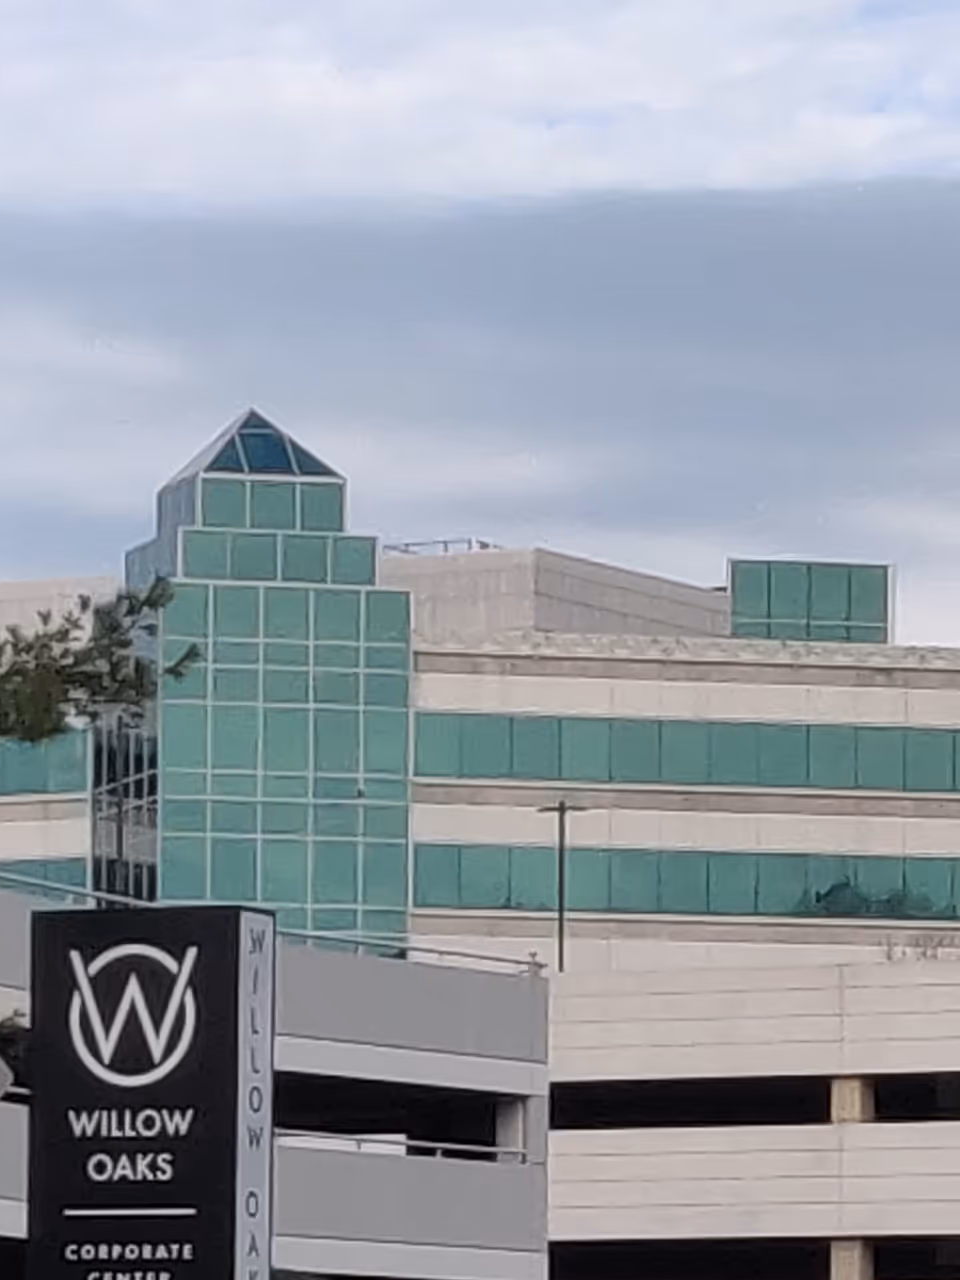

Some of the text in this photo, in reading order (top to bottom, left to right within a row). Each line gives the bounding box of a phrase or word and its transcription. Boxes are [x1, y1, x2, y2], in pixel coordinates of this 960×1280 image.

[248, 928, 265, 1149] WILLOW
[67, 1108, 194, 1138] WILLOW
[86, 1152, 174, 1182] OAKS
[64, 1243, 194, 1261] CORPORATE
